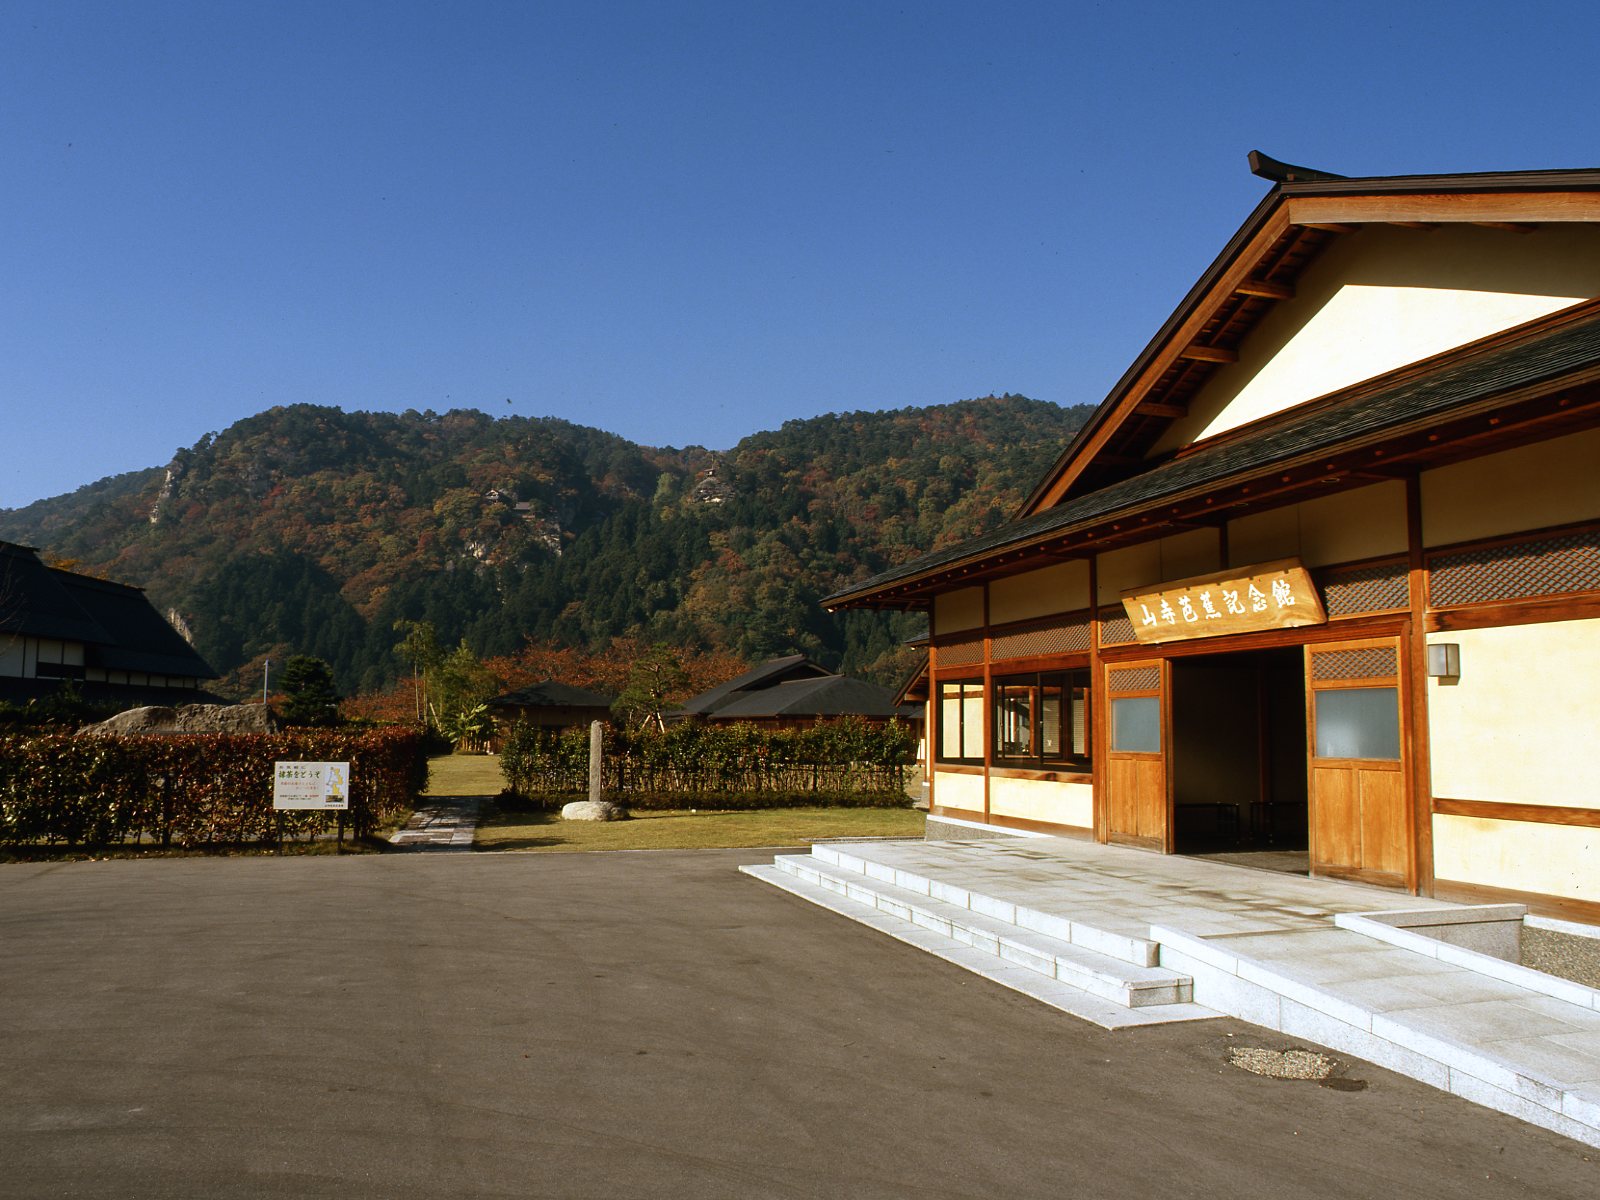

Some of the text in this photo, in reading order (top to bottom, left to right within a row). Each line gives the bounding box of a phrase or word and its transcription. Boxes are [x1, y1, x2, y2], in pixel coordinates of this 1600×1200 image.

[1141, 579, 1296, 627] 山寺芭蕉記念館
